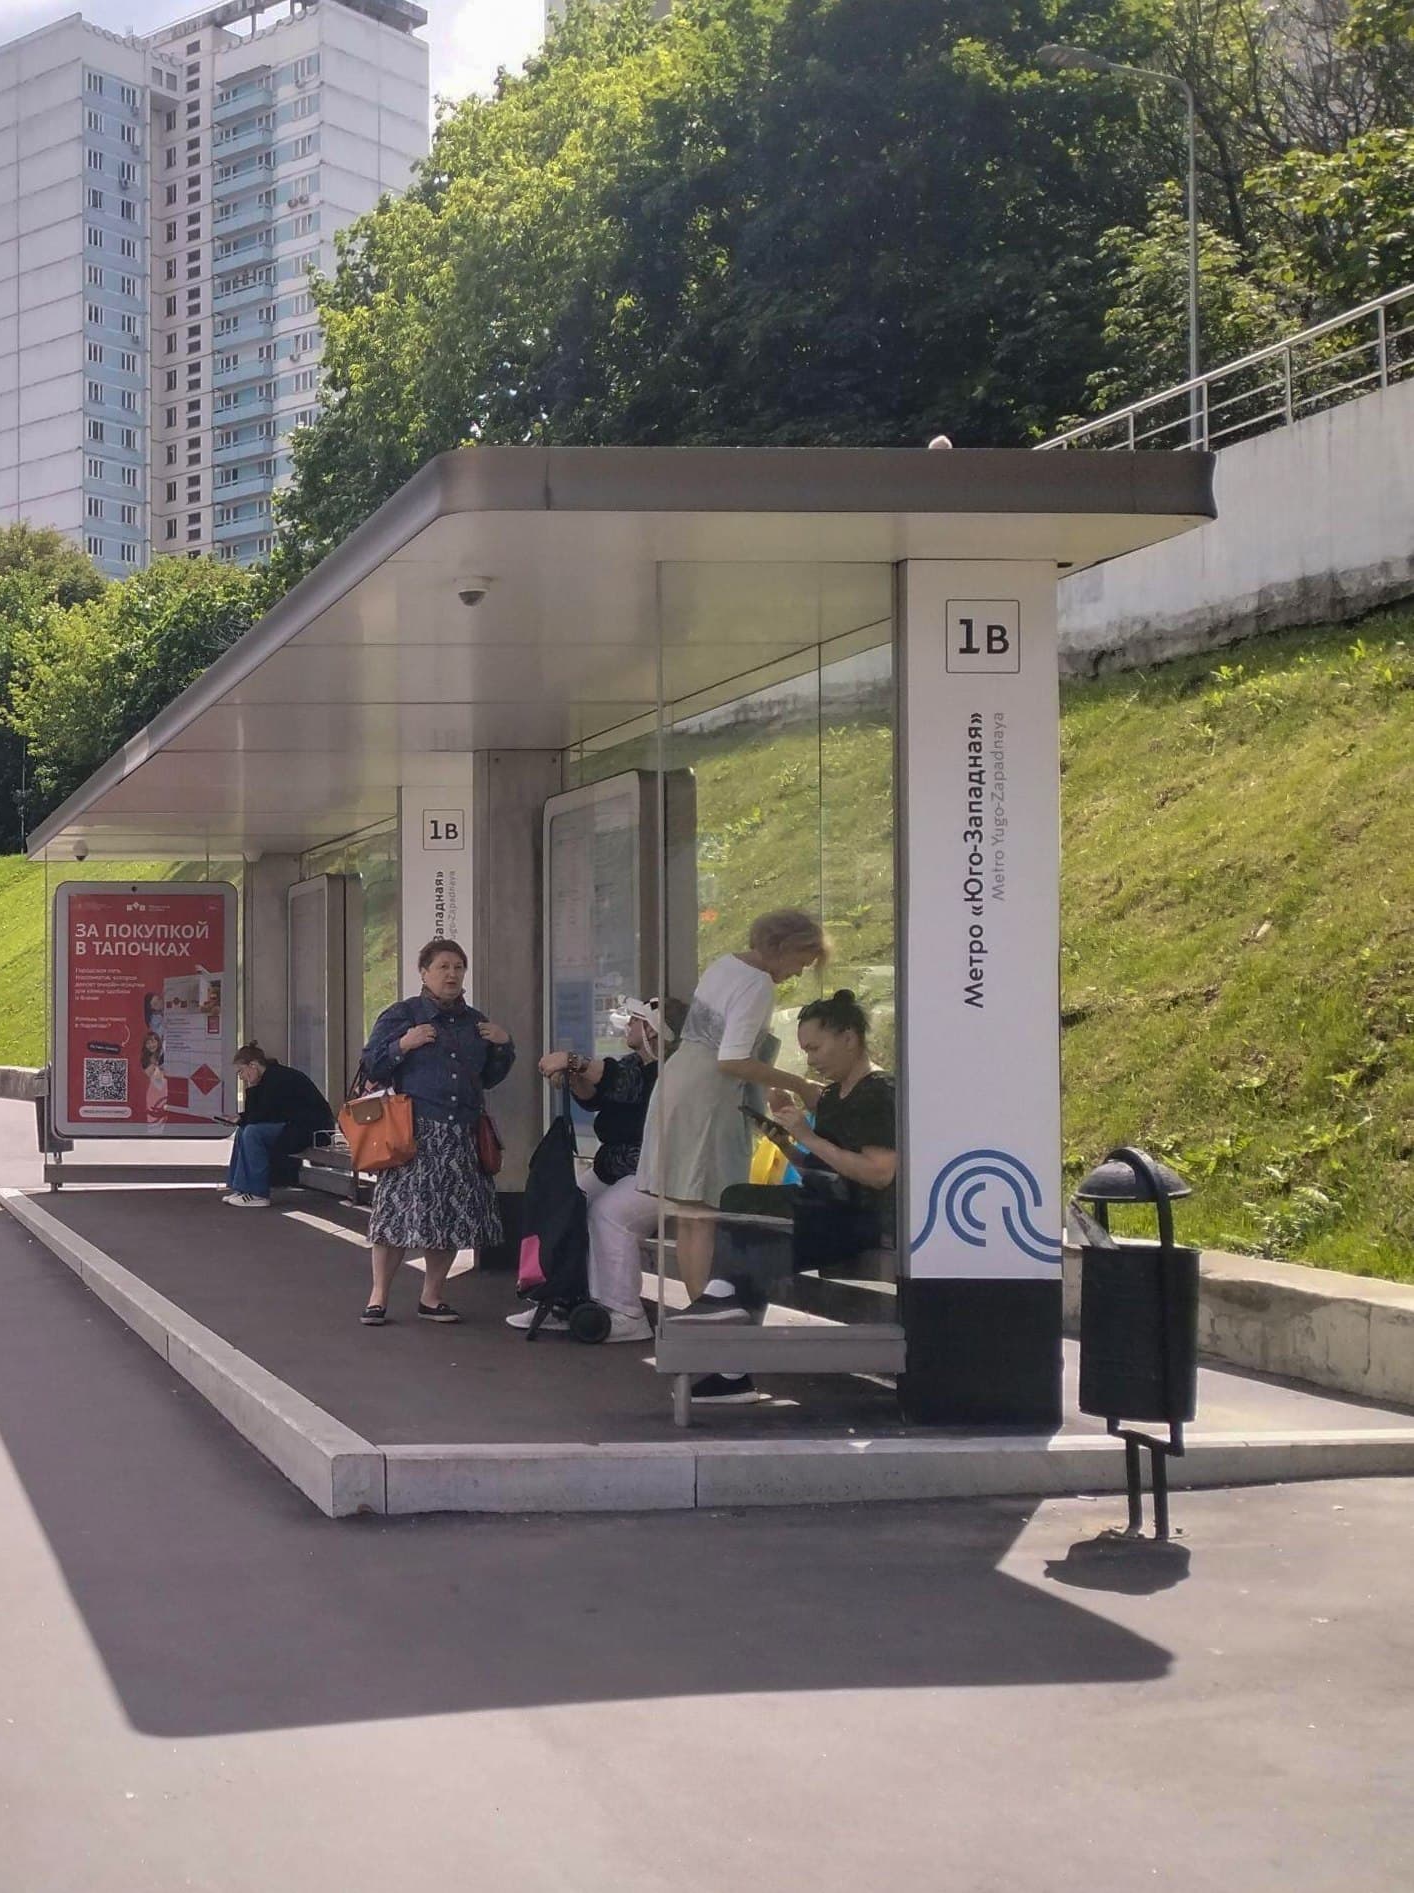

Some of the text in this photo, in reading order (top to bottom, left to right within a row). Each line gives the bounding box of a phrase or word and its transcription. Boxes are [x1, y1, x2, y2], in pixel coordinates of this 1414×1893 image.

[990, 712, 1008, 901] Metro Yugo-Zapadnaya
[963, 712, 988, 1009] Метро «Юго-Западная»
[75, 920, 209, 939] ЗА ПОКУПКОЙ
[75, 941, 191, 957] В ТАПОЧКАХ
